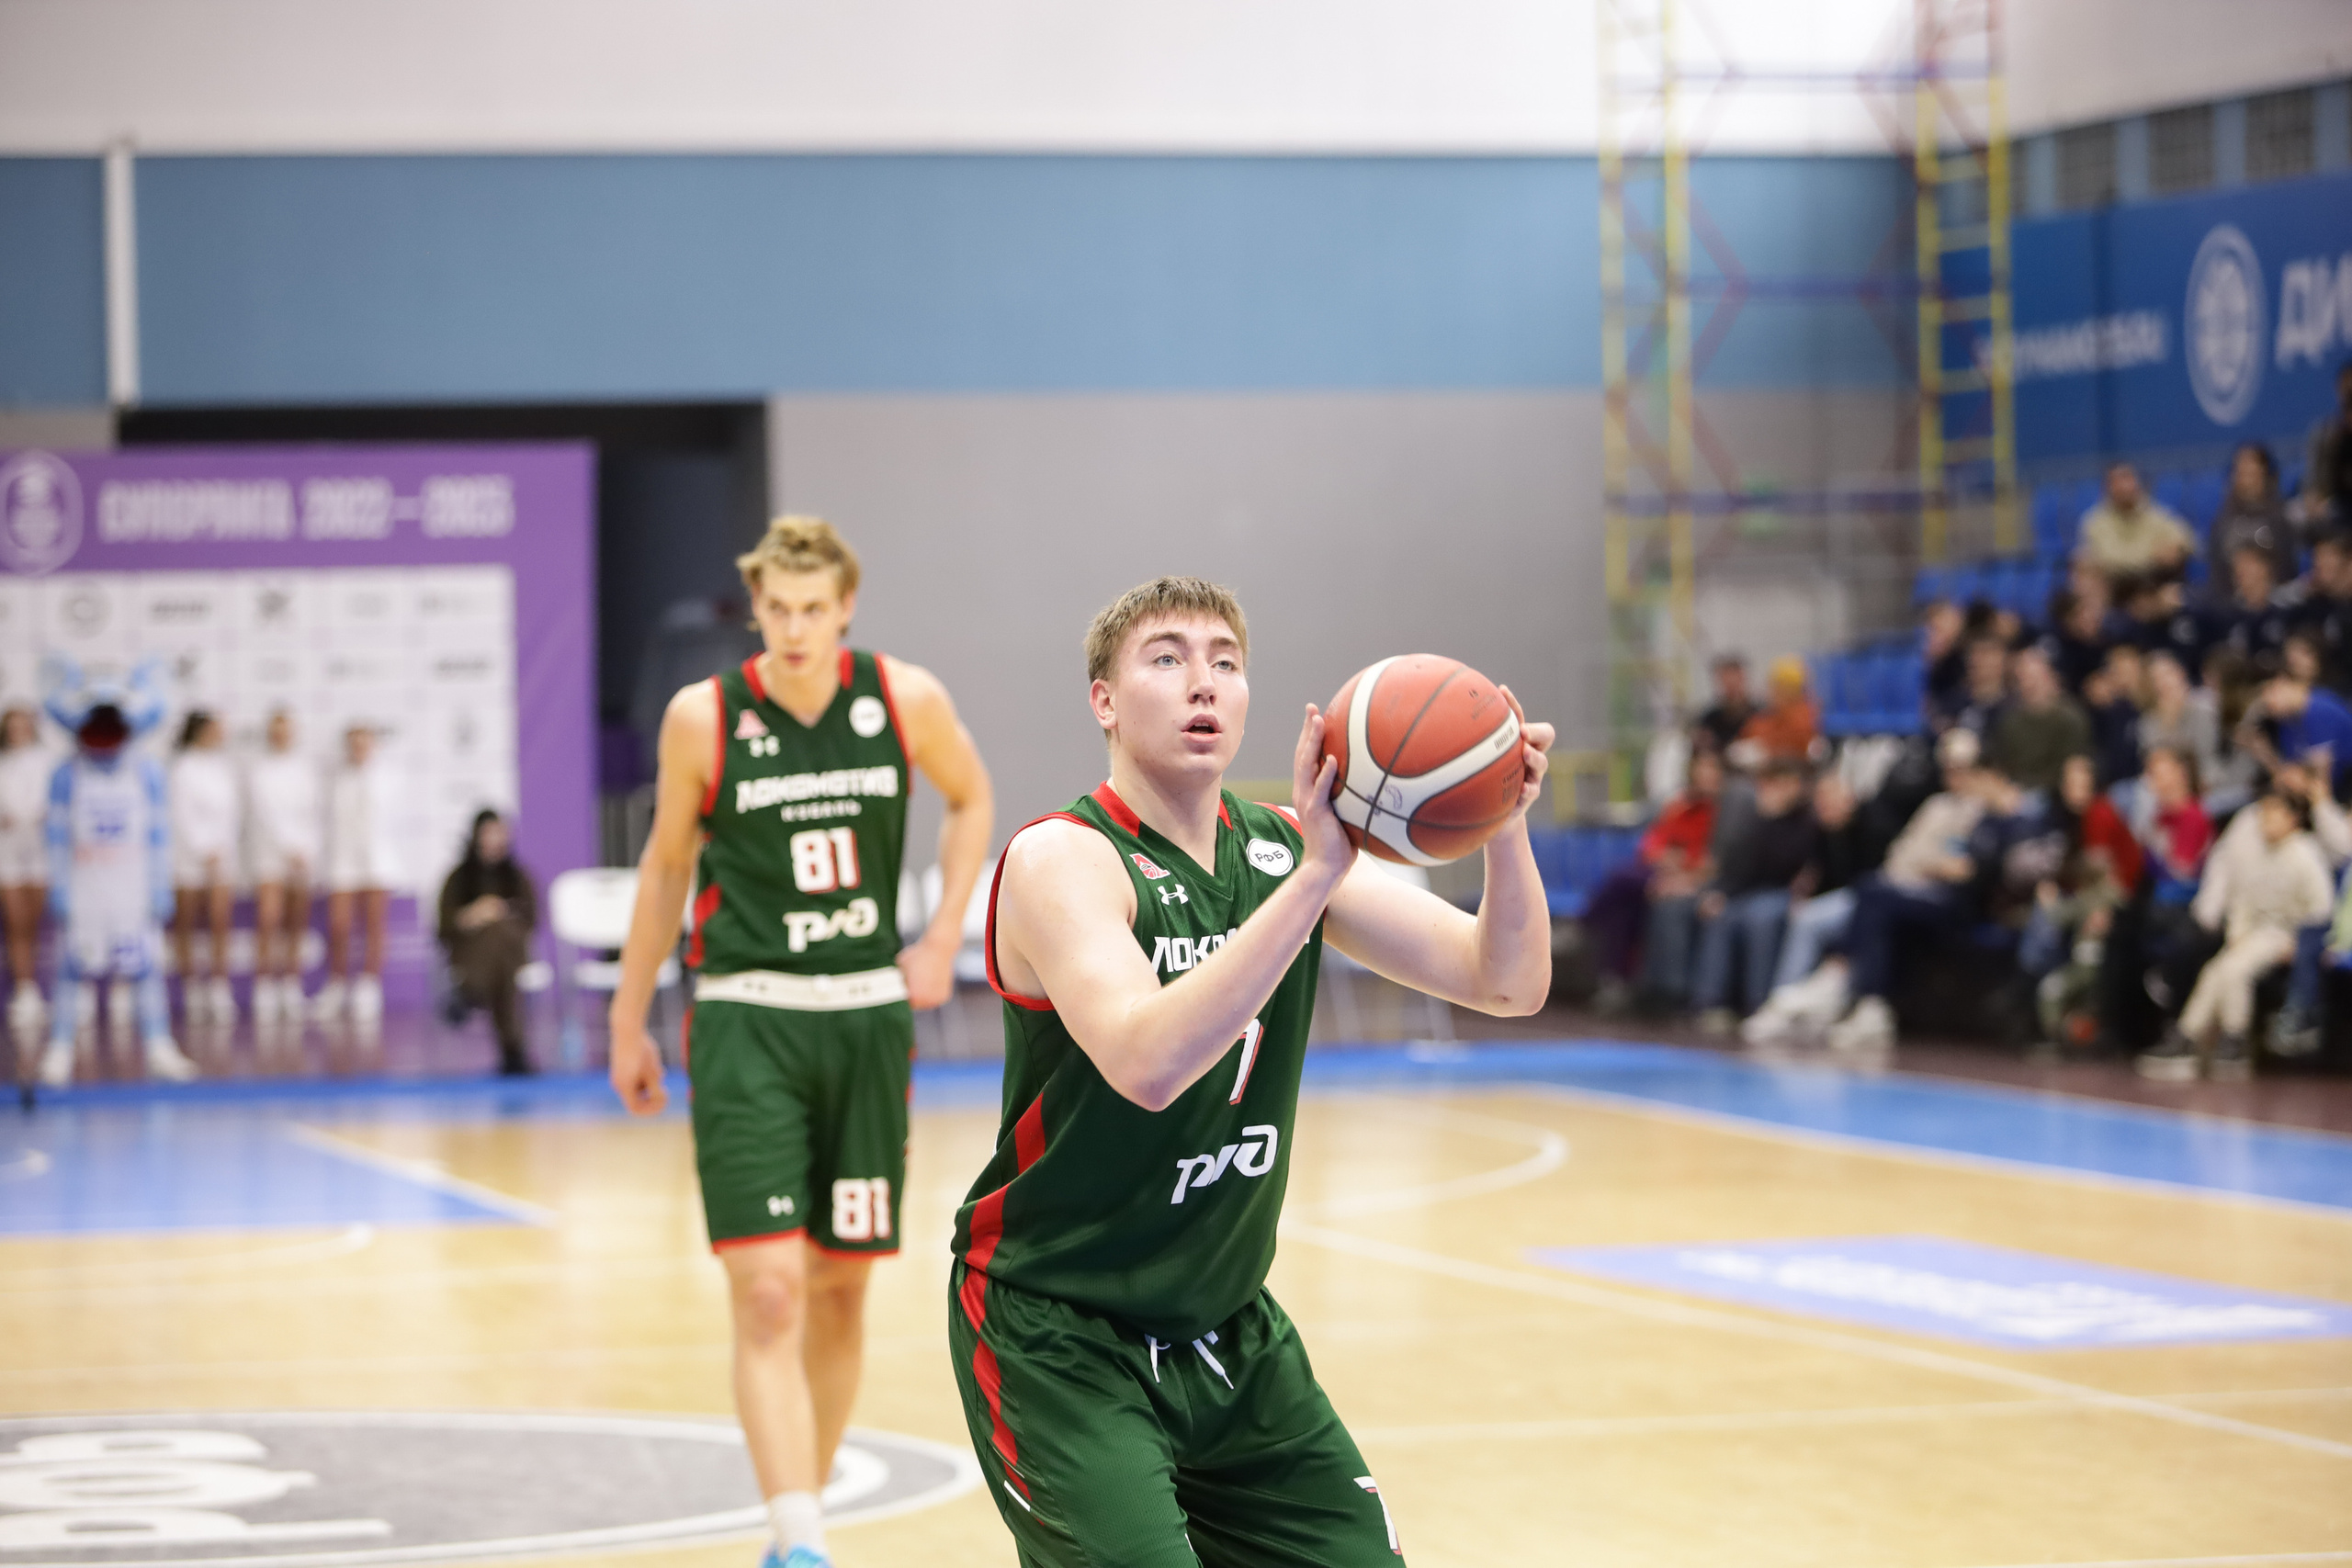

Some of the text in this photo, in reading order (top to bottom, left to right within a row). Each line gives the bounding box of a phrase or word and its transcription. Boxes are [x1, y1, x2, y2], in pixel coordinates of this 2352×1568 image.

[790, 826, 862, 895] 81
[1255, 850, 1284, 863] РФБ
[831, 1177, 893, 1243] 81
